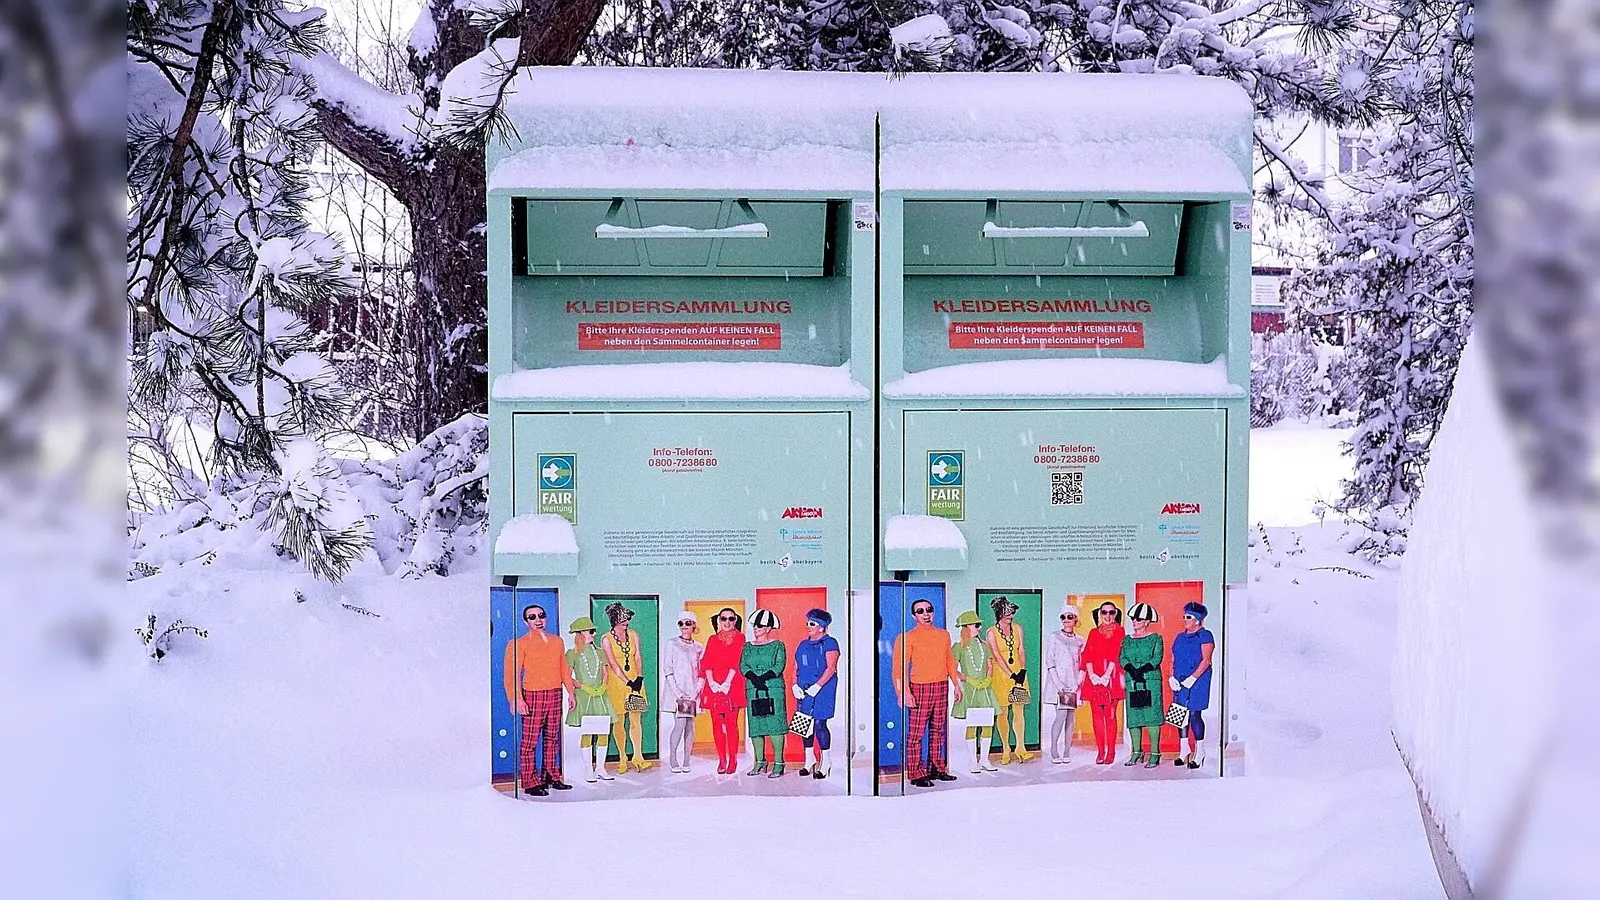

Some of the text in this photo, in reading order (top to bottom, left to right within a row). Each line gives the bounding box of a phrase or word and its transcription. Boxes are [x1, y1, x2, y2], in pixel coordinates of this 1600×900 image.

[566, 300, 792, 314] KLEIDERSAMMLUNG
[933, 300, 1152, 313] KLEIDERSAMMLUNG
[586, 326, 775, 336] Bitte Ihre Kleiderspenden AUF KEINEN FALL
[956, 325, 1138, 335] Bitte Ihre Kleiderspenden AUF KEINEN FALL
[604, 338, 760, 347] neben den Sammelcontainer legen!
[974, 336, 1123, 346] neben den Sammelcontainer legen!
[653, 448, 713, 456] Info-Telefon:
[1038, 444, 1096, 452] Info-Telefon:
[542, 492, 572, 504] FAIR
[931, 489, 960, 500] FAIR
[542, 506, 573, 514] wertung
[932, 502, 960, 510] wertung
